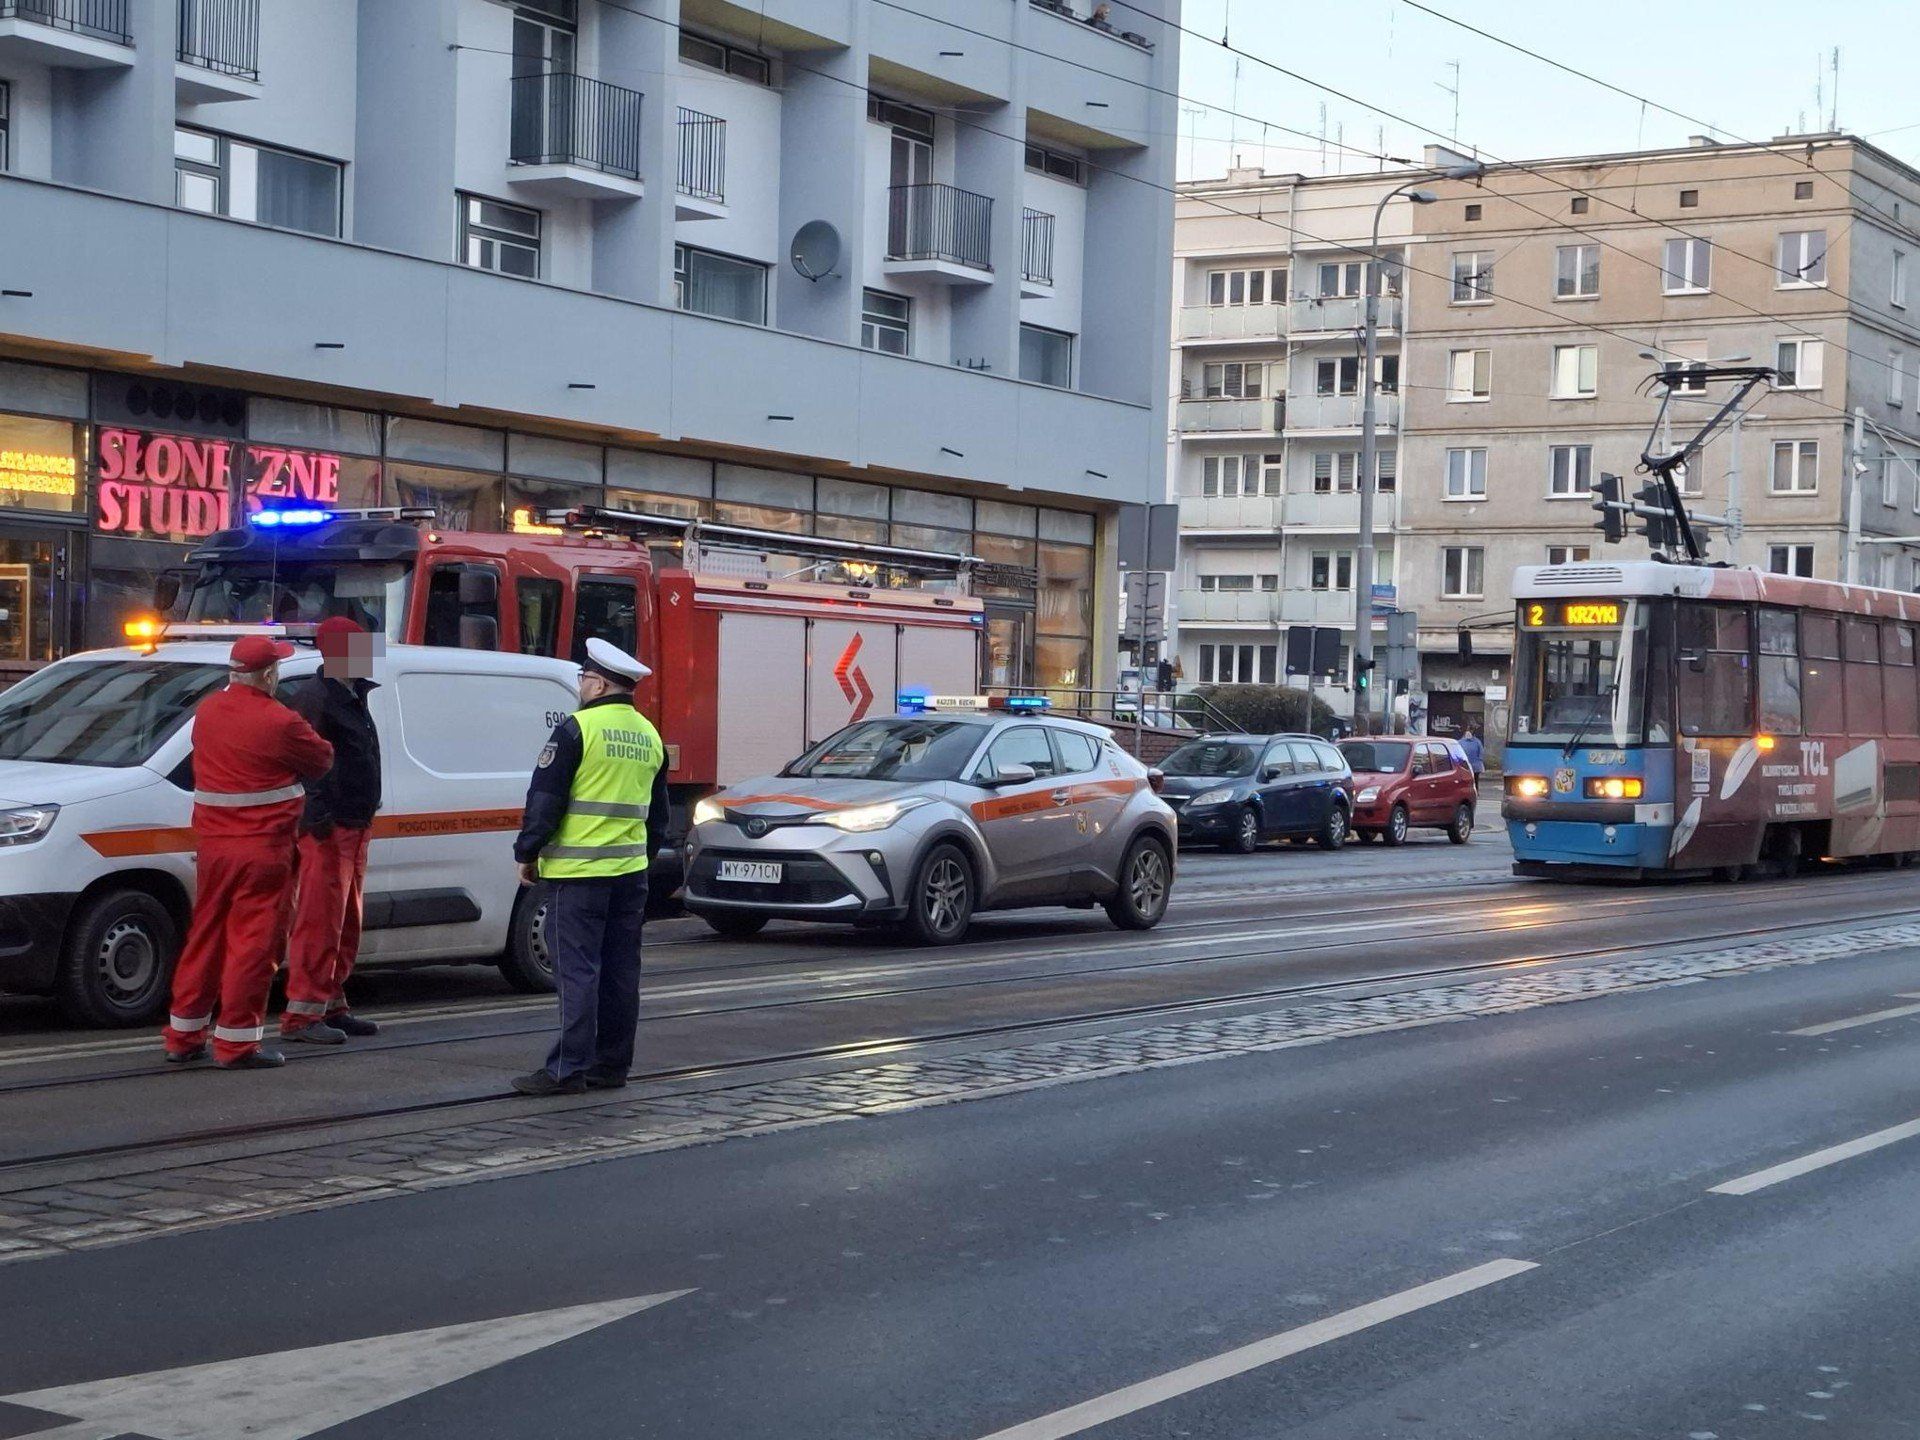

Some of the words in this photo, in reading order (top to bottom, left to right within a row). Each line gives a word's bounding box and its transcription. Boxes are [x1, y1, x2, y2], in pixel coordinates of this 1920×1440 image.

[1531, 605, 1543, 625] 2
[1567, 605, 1618, 624] KRZYKI
[602, 728, 652, 748] NADZÓR
[606, 744, 650, 763] RUCHU
[1800, 741, 1829, 776] TCL
[398, 819, 458, 833] POGOTOWIE
[724, 862, 739, 877] WY
[743, 863, 780, 879] 971CN
